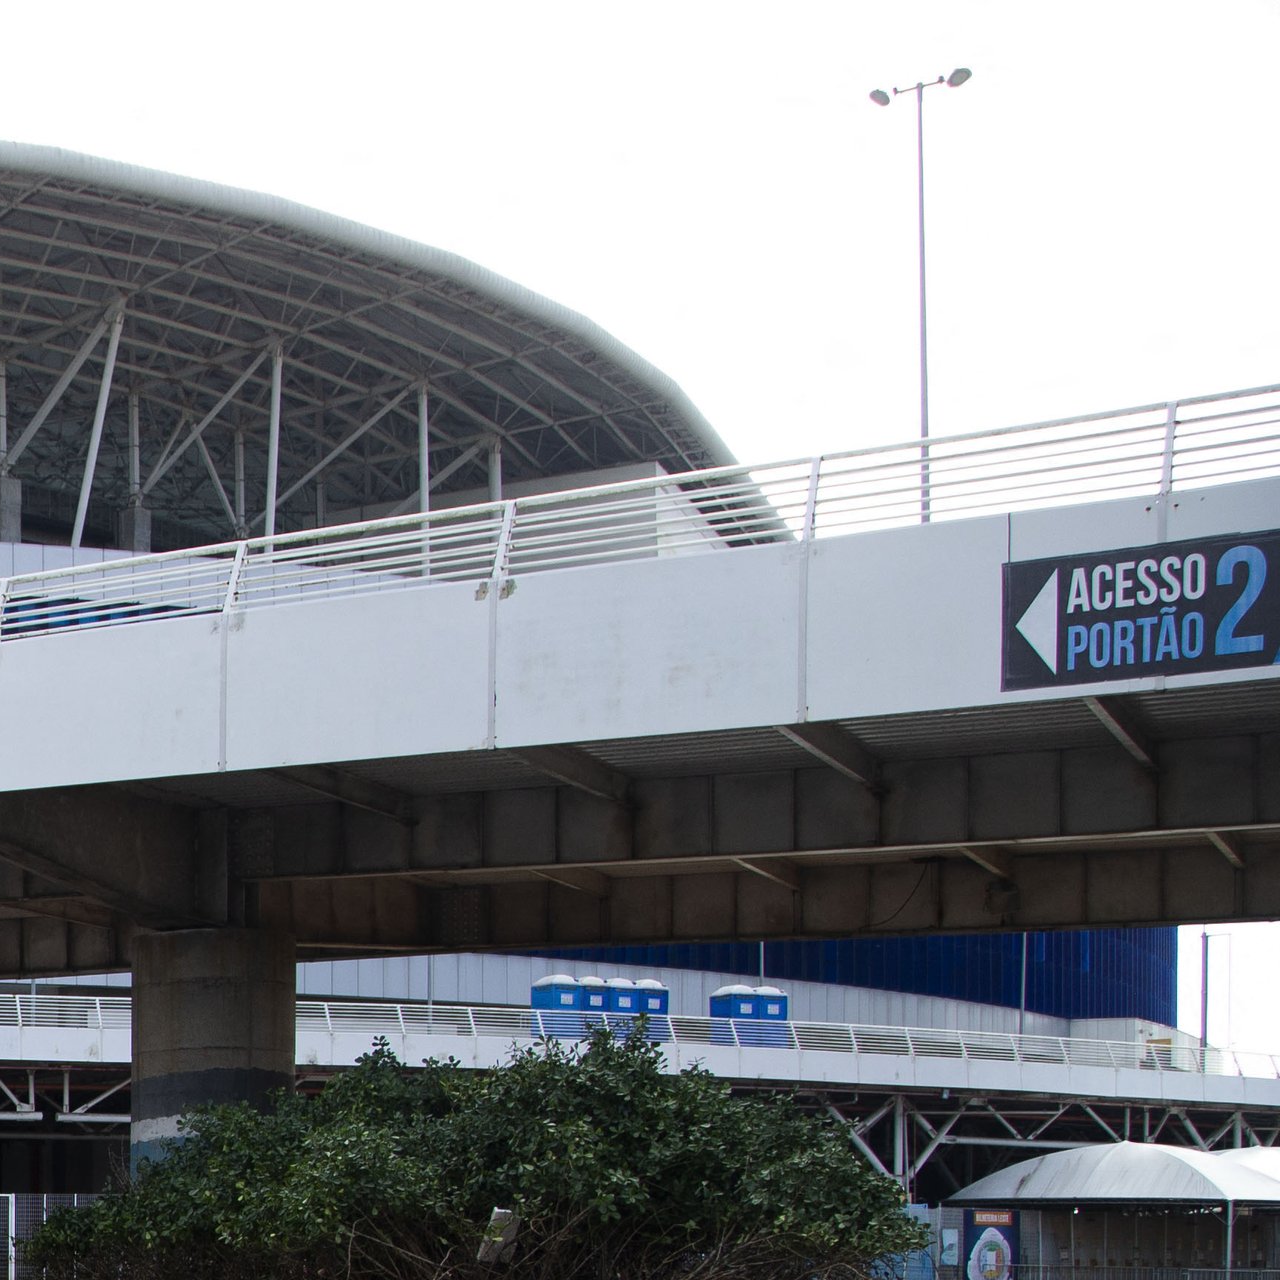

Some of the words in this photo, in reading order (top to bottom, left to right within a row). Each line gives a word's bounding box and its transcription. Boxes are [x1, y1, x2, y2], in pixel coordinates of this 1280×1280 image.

[1066, 553, 1207, 614] ACESSO
[1214, 545, 1267, 656] 2
[1067, 606, 1205, 671] PORTÃO
